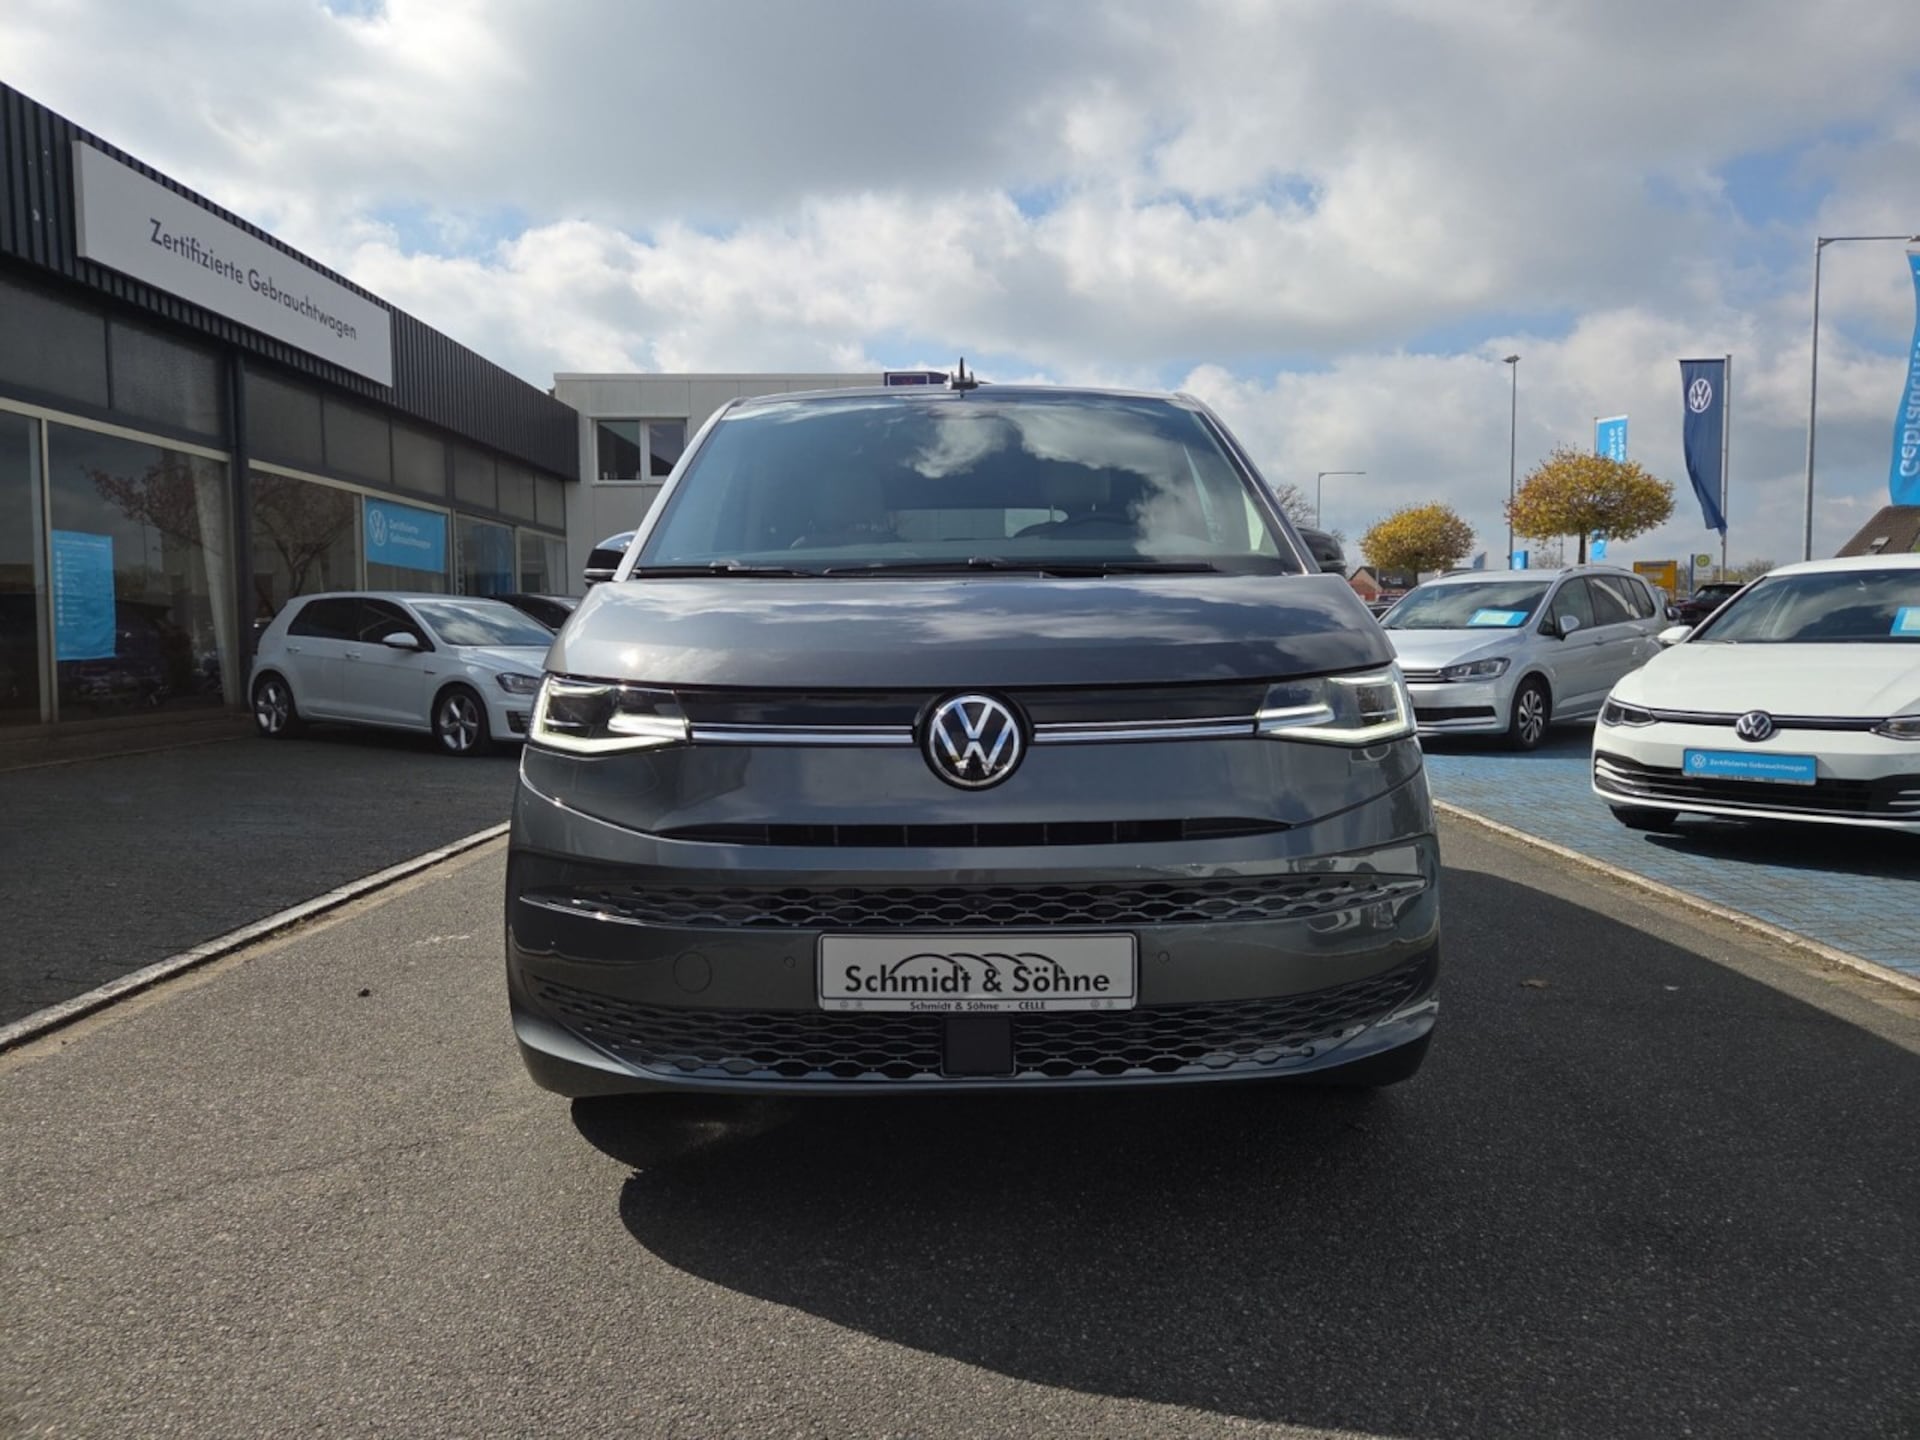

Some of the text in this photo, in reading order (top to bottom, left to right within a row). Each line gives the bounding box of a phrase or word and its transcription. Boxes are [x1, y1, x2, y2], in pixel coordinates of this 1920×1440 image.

[150, 218, 357, 340] Zertifizierte Gebrauchtwagen
[845, 964, 1110, 993] Schmidt & Söhne
[909, 1000, 951, 1010] Schmidt
[966, 1000, 999, 1010] Söhne
[1019, 1001, 1046, 1010] CELLE
